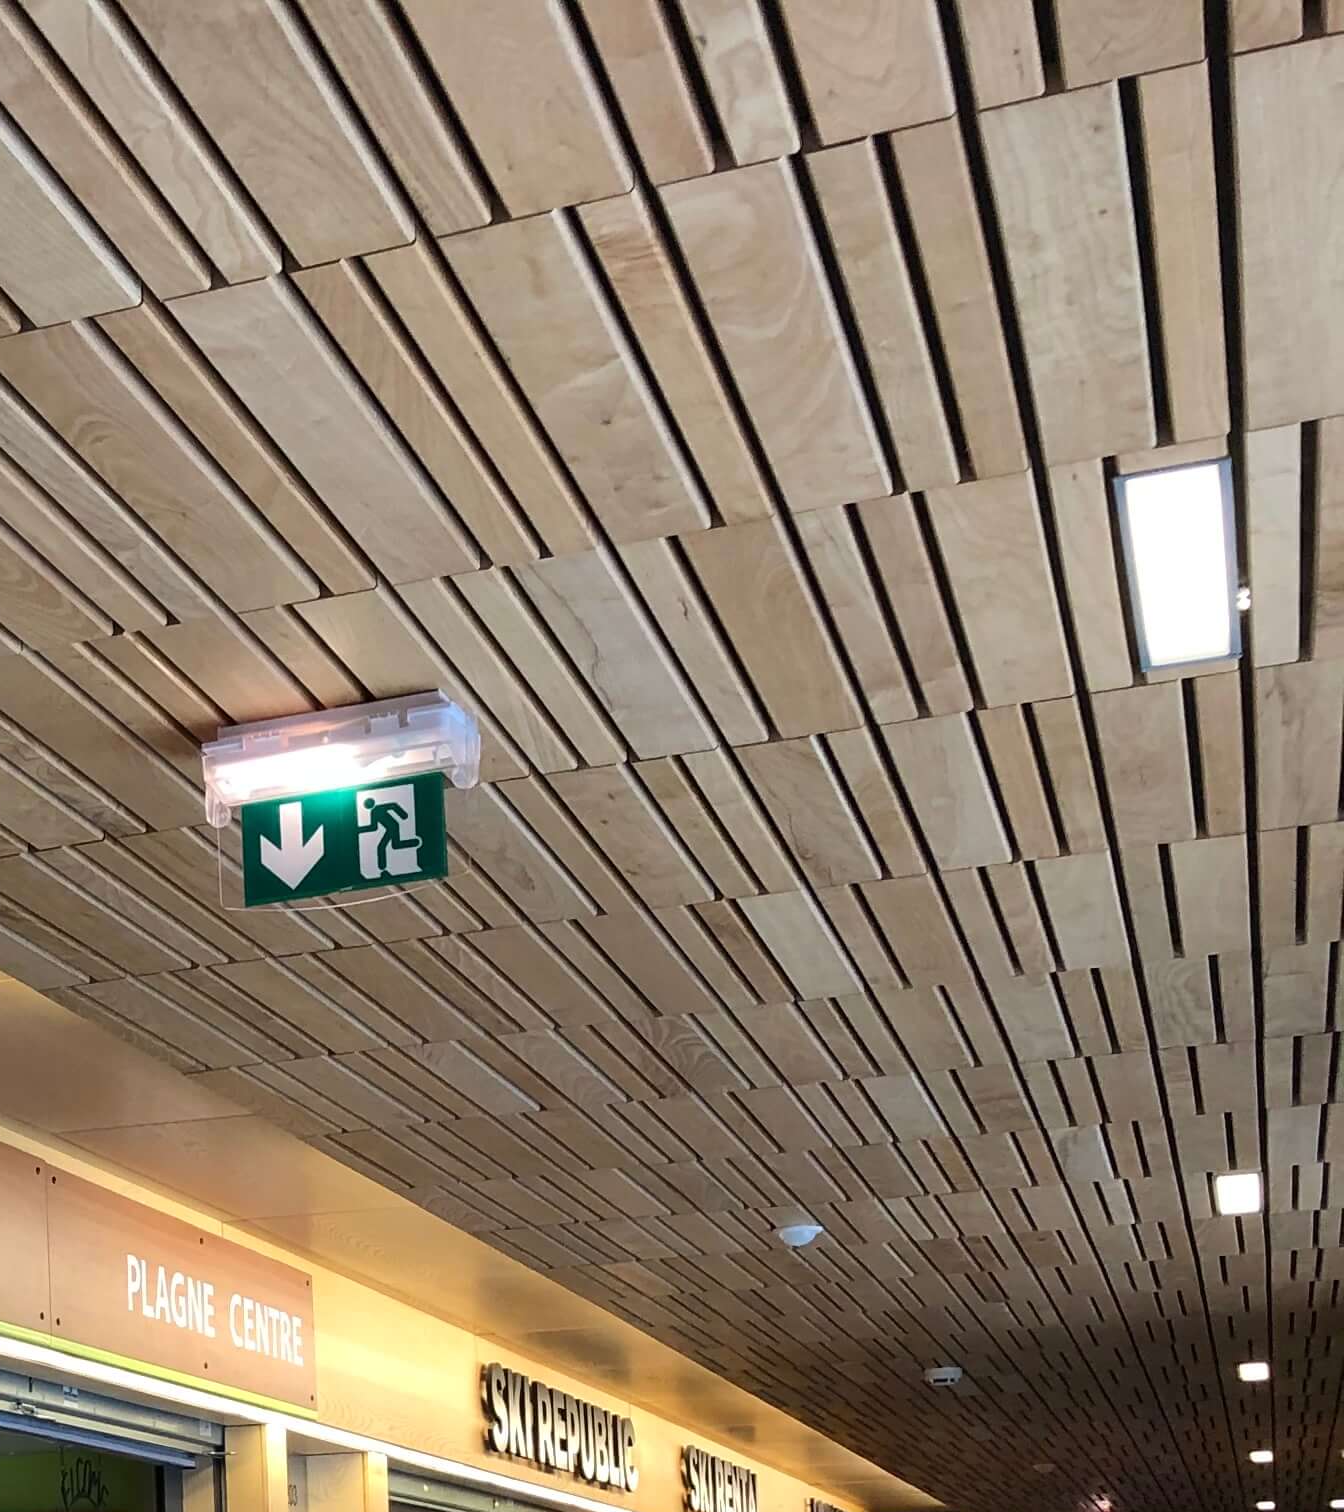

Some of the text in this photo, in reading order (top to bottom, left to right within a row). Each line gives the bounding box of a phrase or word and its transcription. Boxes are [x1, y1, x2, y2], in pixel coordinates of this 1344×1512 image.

[127, 1254, 304, 1367] PLAGNE CENTRE
[485, 1362, 640, 1492] SKI REPUBLIC
